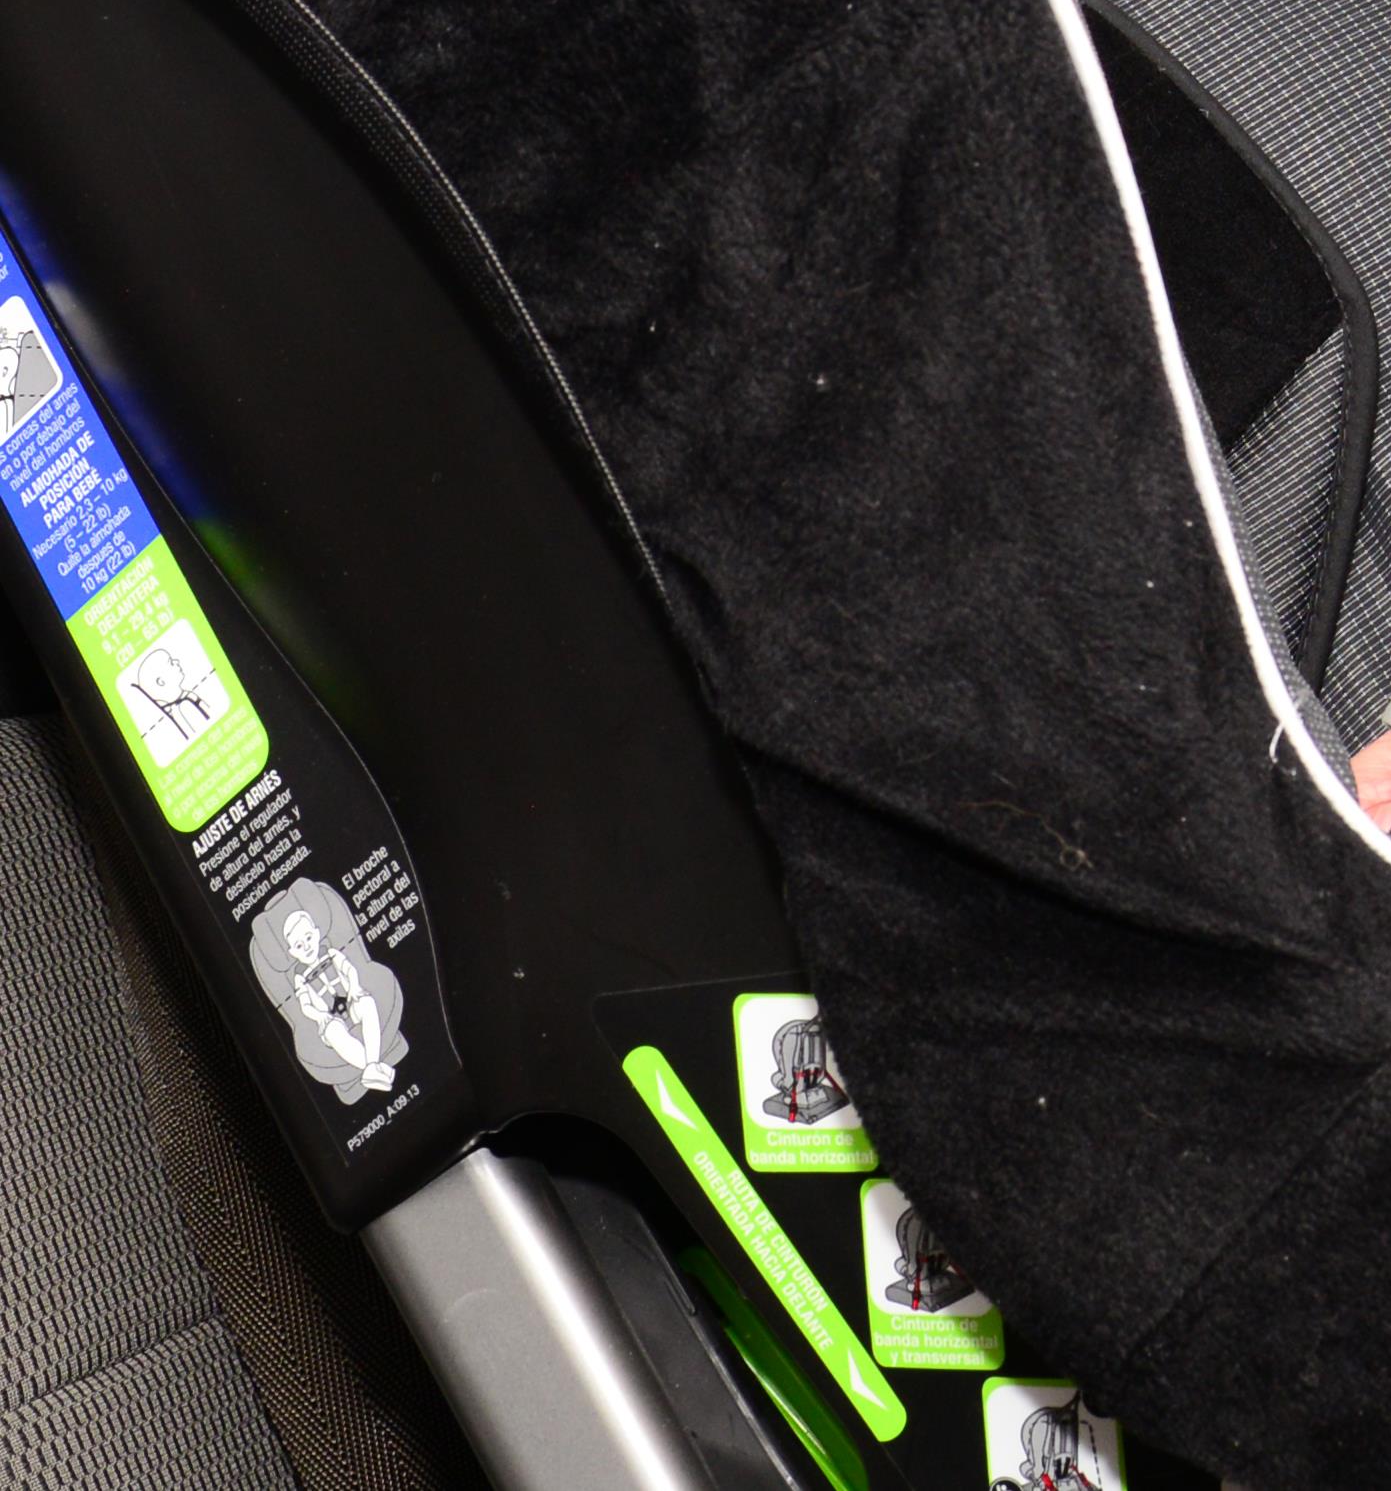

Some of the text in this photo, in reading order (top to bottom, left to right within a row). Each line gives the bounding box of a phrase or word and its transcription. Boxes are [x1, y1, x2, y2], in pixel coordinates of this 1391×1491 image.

[6, 420, 39, 455] correas
[39, 403, 54, 424] del
[10, 465, 32, 491] nivel
[31, 450, 46, 471] del
[44, 416, 85, 459] hombros
[13, 457, 21, 469] o
[20, 441, 36, 465] por
[36, 414, 66, 447] debajo
[65, 398, 80, 418] del
[20, 430, 95, 508] ALMOHADA DE
[31, 515, 77, 560] Necesario
[101, 478, 115, 496] 10
[112, 468, 128, 485] kg
[43, 495, 75, 529] PARA
[80, 543, 92, 557] la
[89, 505, 132, 549] almohada
[82, 514, 98, 533] 22
[112, 530, 126, 547] de
[81, 577, 96, 594] 10
[93, 567, 109, 584] kg
[191, 769, 282, 859] AJUSTE DE ARNÉS
[198, 787, 292, 877] Presione el regulador
[209, 876, 223, 893] de
[222, 852, 250, 881] altura
[248, 835, 264, 857] del
[291, 804, 301, 821] y
[263, 837, 292, 866] hasta
[289, 828, 302, 842] la
[270, 845, 312, 885] deseada.
[341, 846, 389, 890] El broche
[352, 860, 401, 910] pectoral a
[354, 871, 411, 928] la altura del
[365, 892, 420, 943] nivel de las
[386, 918, 417, 950] axilas
[749, 1149, 874, 1165] banda horizontal
[835, 1132, 854, 1147] de
[727, 1169, 760, 1211] RUTA
[753, 1210, 778, 1235] DE
[692, 1150, 834, 1351] ORIENTADA HACIA DELANTE
[873, 1331, 998, 1350] banda horizontal
[959, 1318, 978, 1333] de
[902, 1349, 986, 1366] transversal
